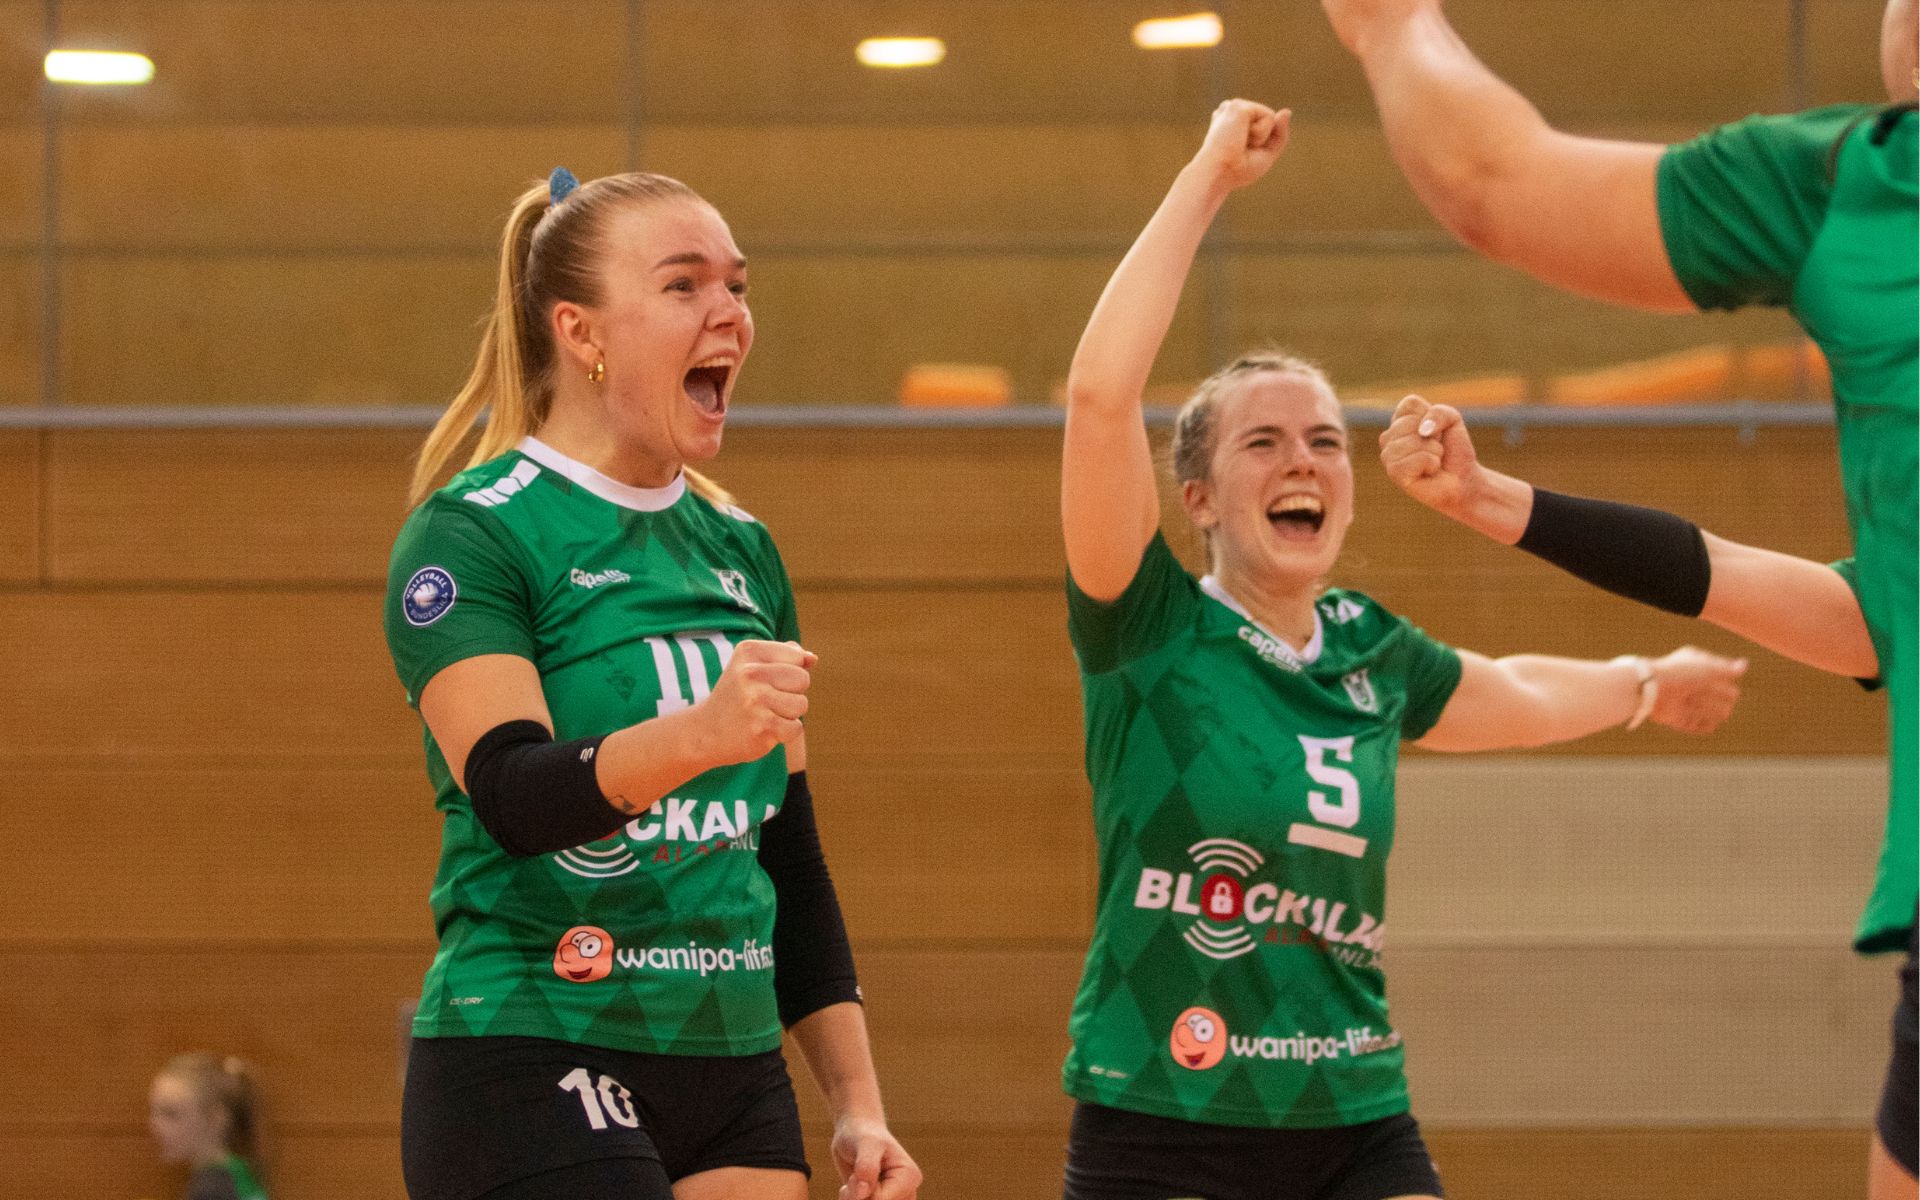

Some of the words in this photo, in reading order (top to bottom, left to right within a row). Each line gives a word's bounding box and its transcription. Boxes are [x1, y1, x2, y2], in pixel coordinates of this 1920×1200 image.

[405, 572, 448, 600] VOLLEYBALL
[1296, 734, 1361, 829] 5
[557, 1067, 640, 1130] 10
